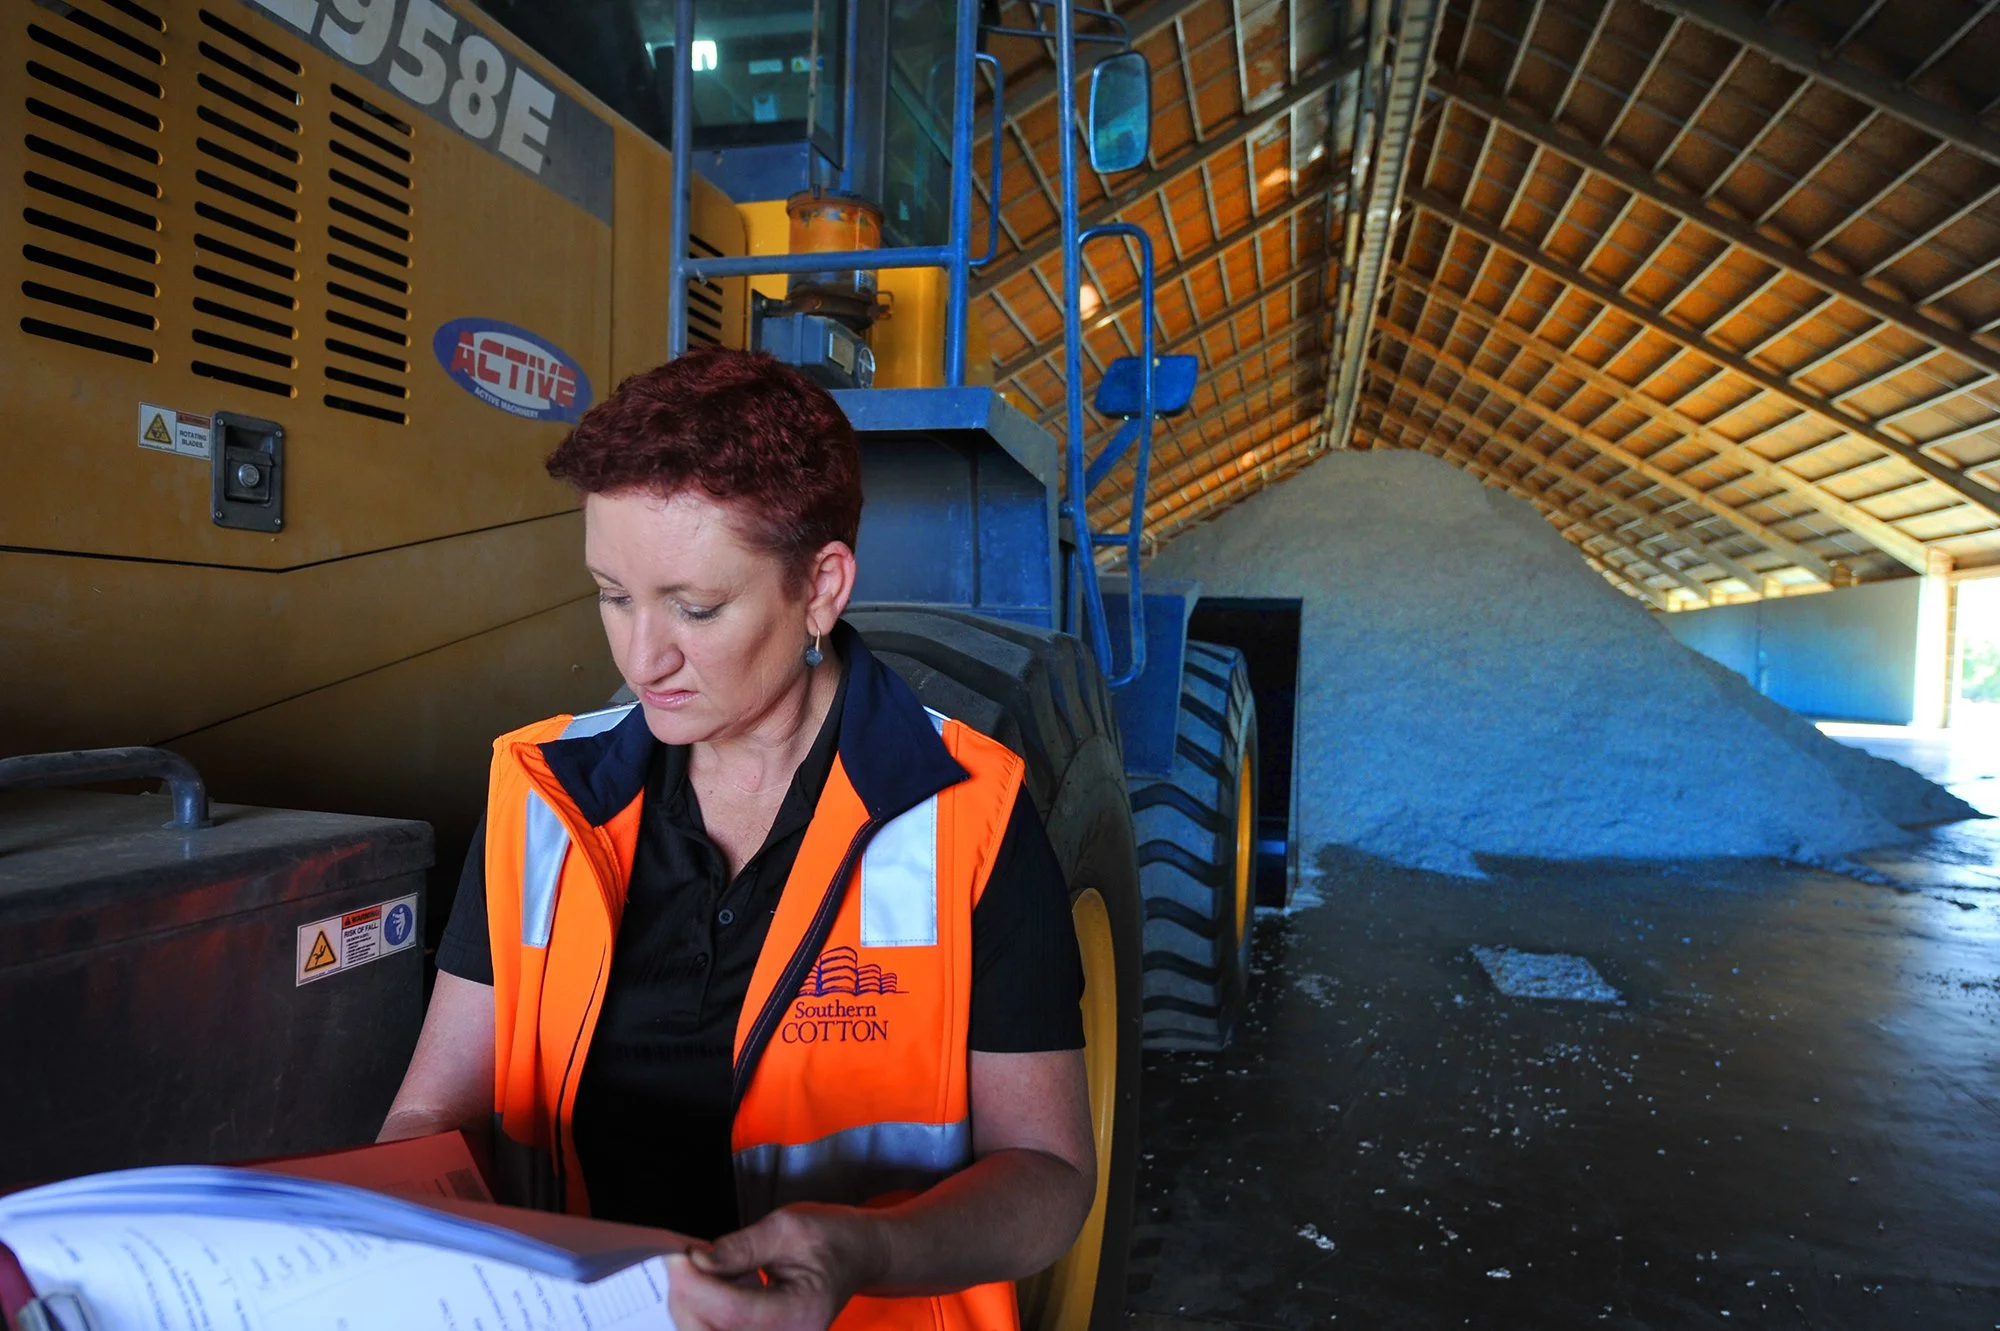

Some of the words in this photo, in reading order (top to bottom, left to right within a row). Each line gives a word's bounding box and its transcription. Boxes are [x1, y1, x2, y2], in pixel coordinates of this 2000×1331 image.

[451, 331, 577, 408] ACTIVE
[473, 387, 500, 407] ACTIVE
[180, 430, 206, 441] ROTATING
[344, 929, 357, 938] RISK
[357, 926, 365, 934] OF
[795, 999, 876, 1018] Southern
[782, 1020, 888, 1043] COTTON
